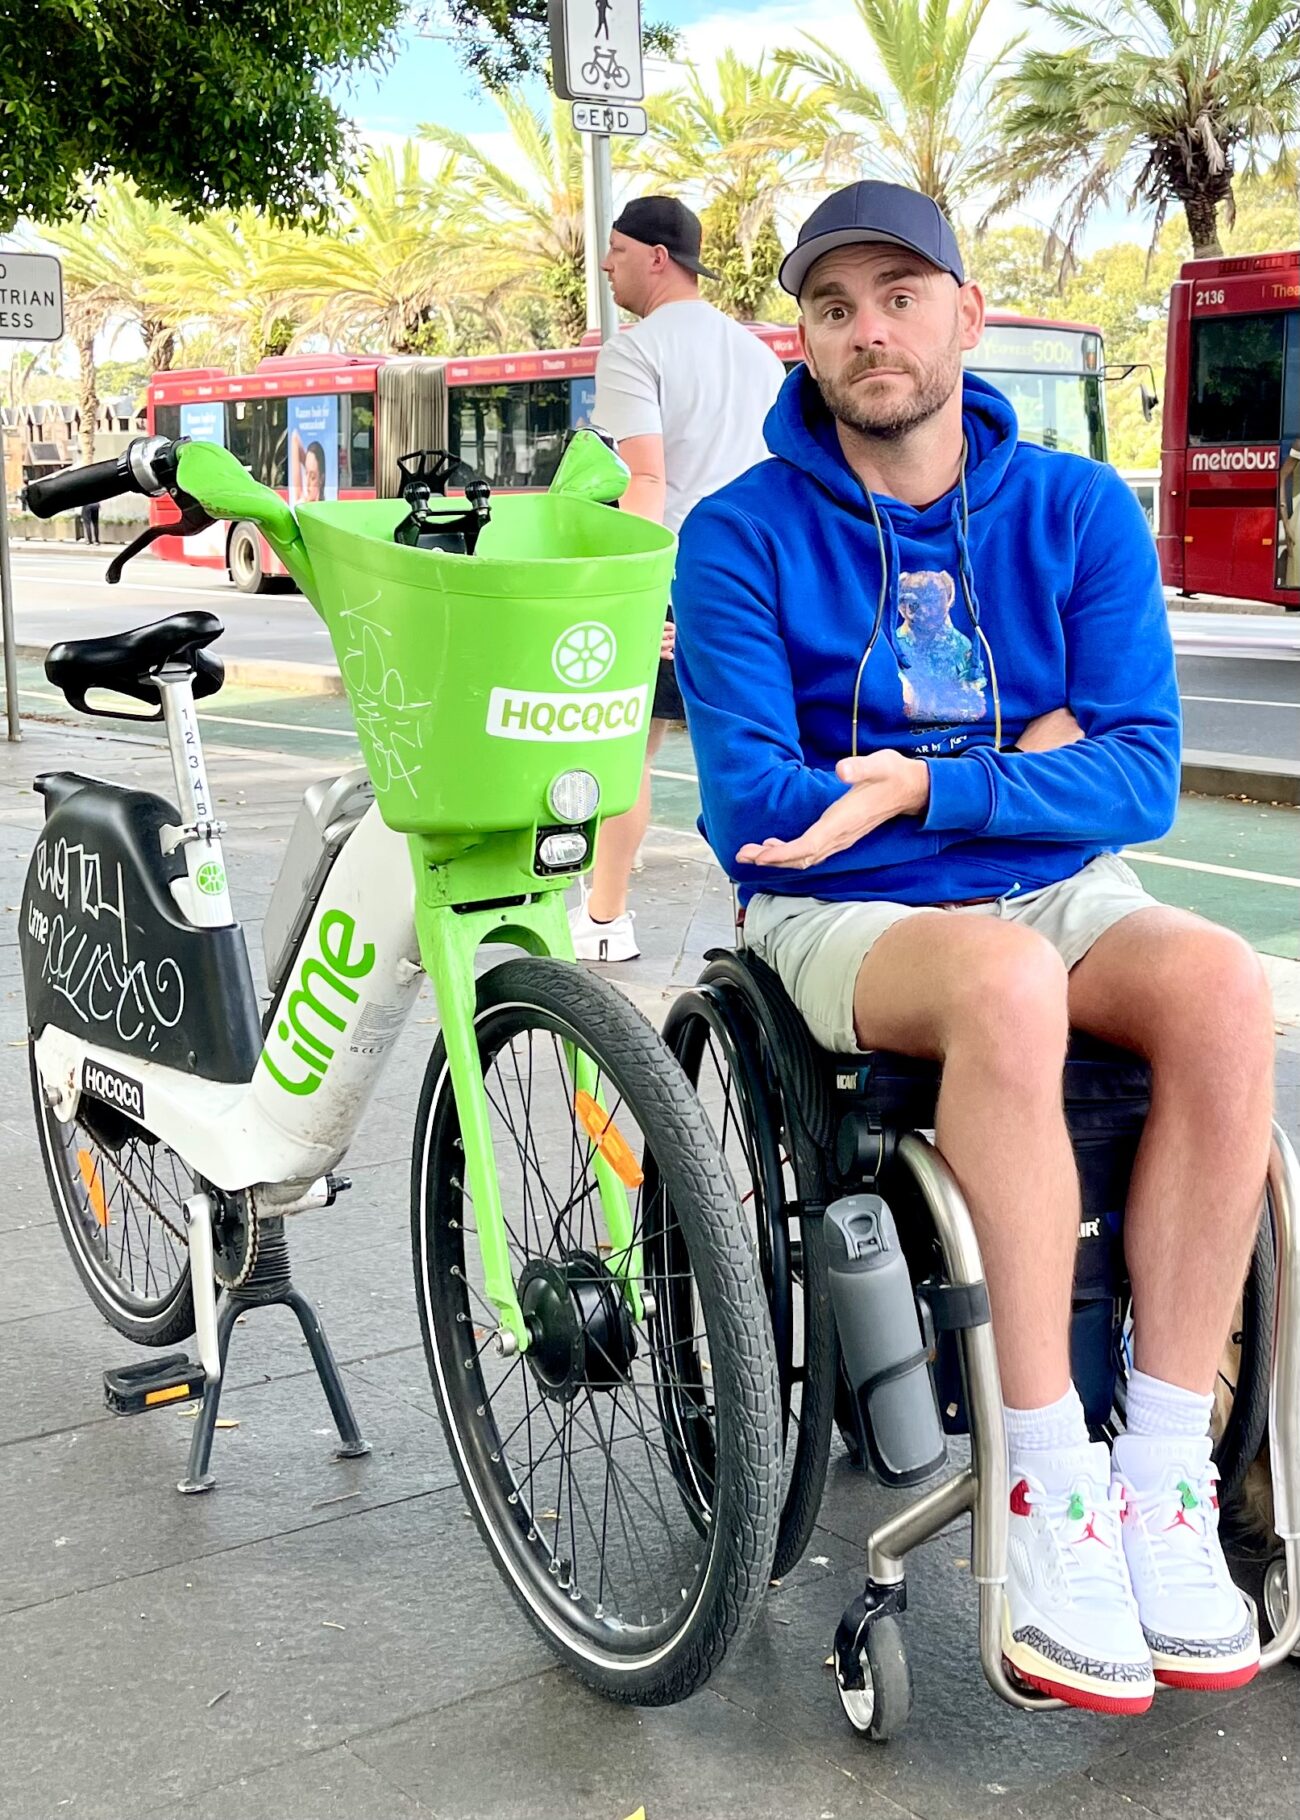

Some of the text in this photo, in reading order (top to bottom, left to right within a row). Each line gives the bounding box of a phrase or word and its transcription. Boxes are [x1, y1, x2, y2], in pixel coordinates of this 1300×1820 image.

[589, 109, 629, 129] END
[1195, 289, 1225, 306] 2136
[1192, 448, 1276, 471] metrobus
[181, 708, 188, 720] 1
[501, 696, 641, 736] HQCQCQ
[185, 731, 195, 744] 2
[188, 755, 199, 768] 3
[194, 780, 203, 791] 4
[196, 803, 207, 816] 5
[261, 909, 376, 1096] Lime
[85, 1065, 141, 1115] HQCQCQ
